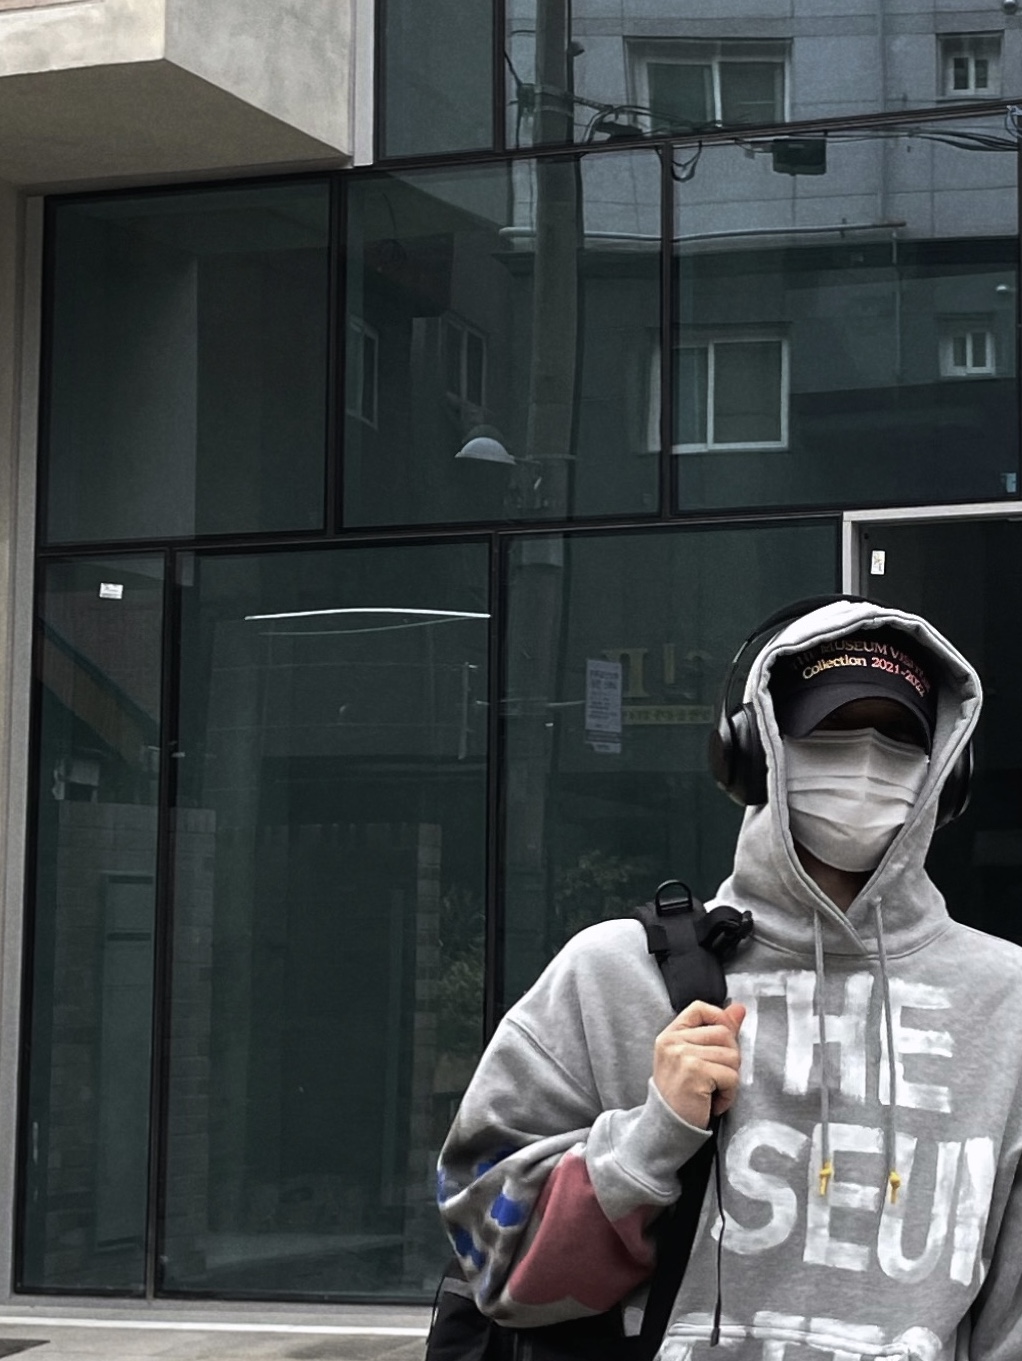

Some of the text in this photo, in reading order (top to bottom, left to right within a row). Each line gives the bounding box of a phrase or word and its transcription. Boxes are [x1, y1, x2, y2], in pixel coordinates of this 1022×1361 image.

[821, 639, 888, 656] MUSEUM
[802, 654, 867, 680] Collection
[725, 969, 955, 1114] THE
